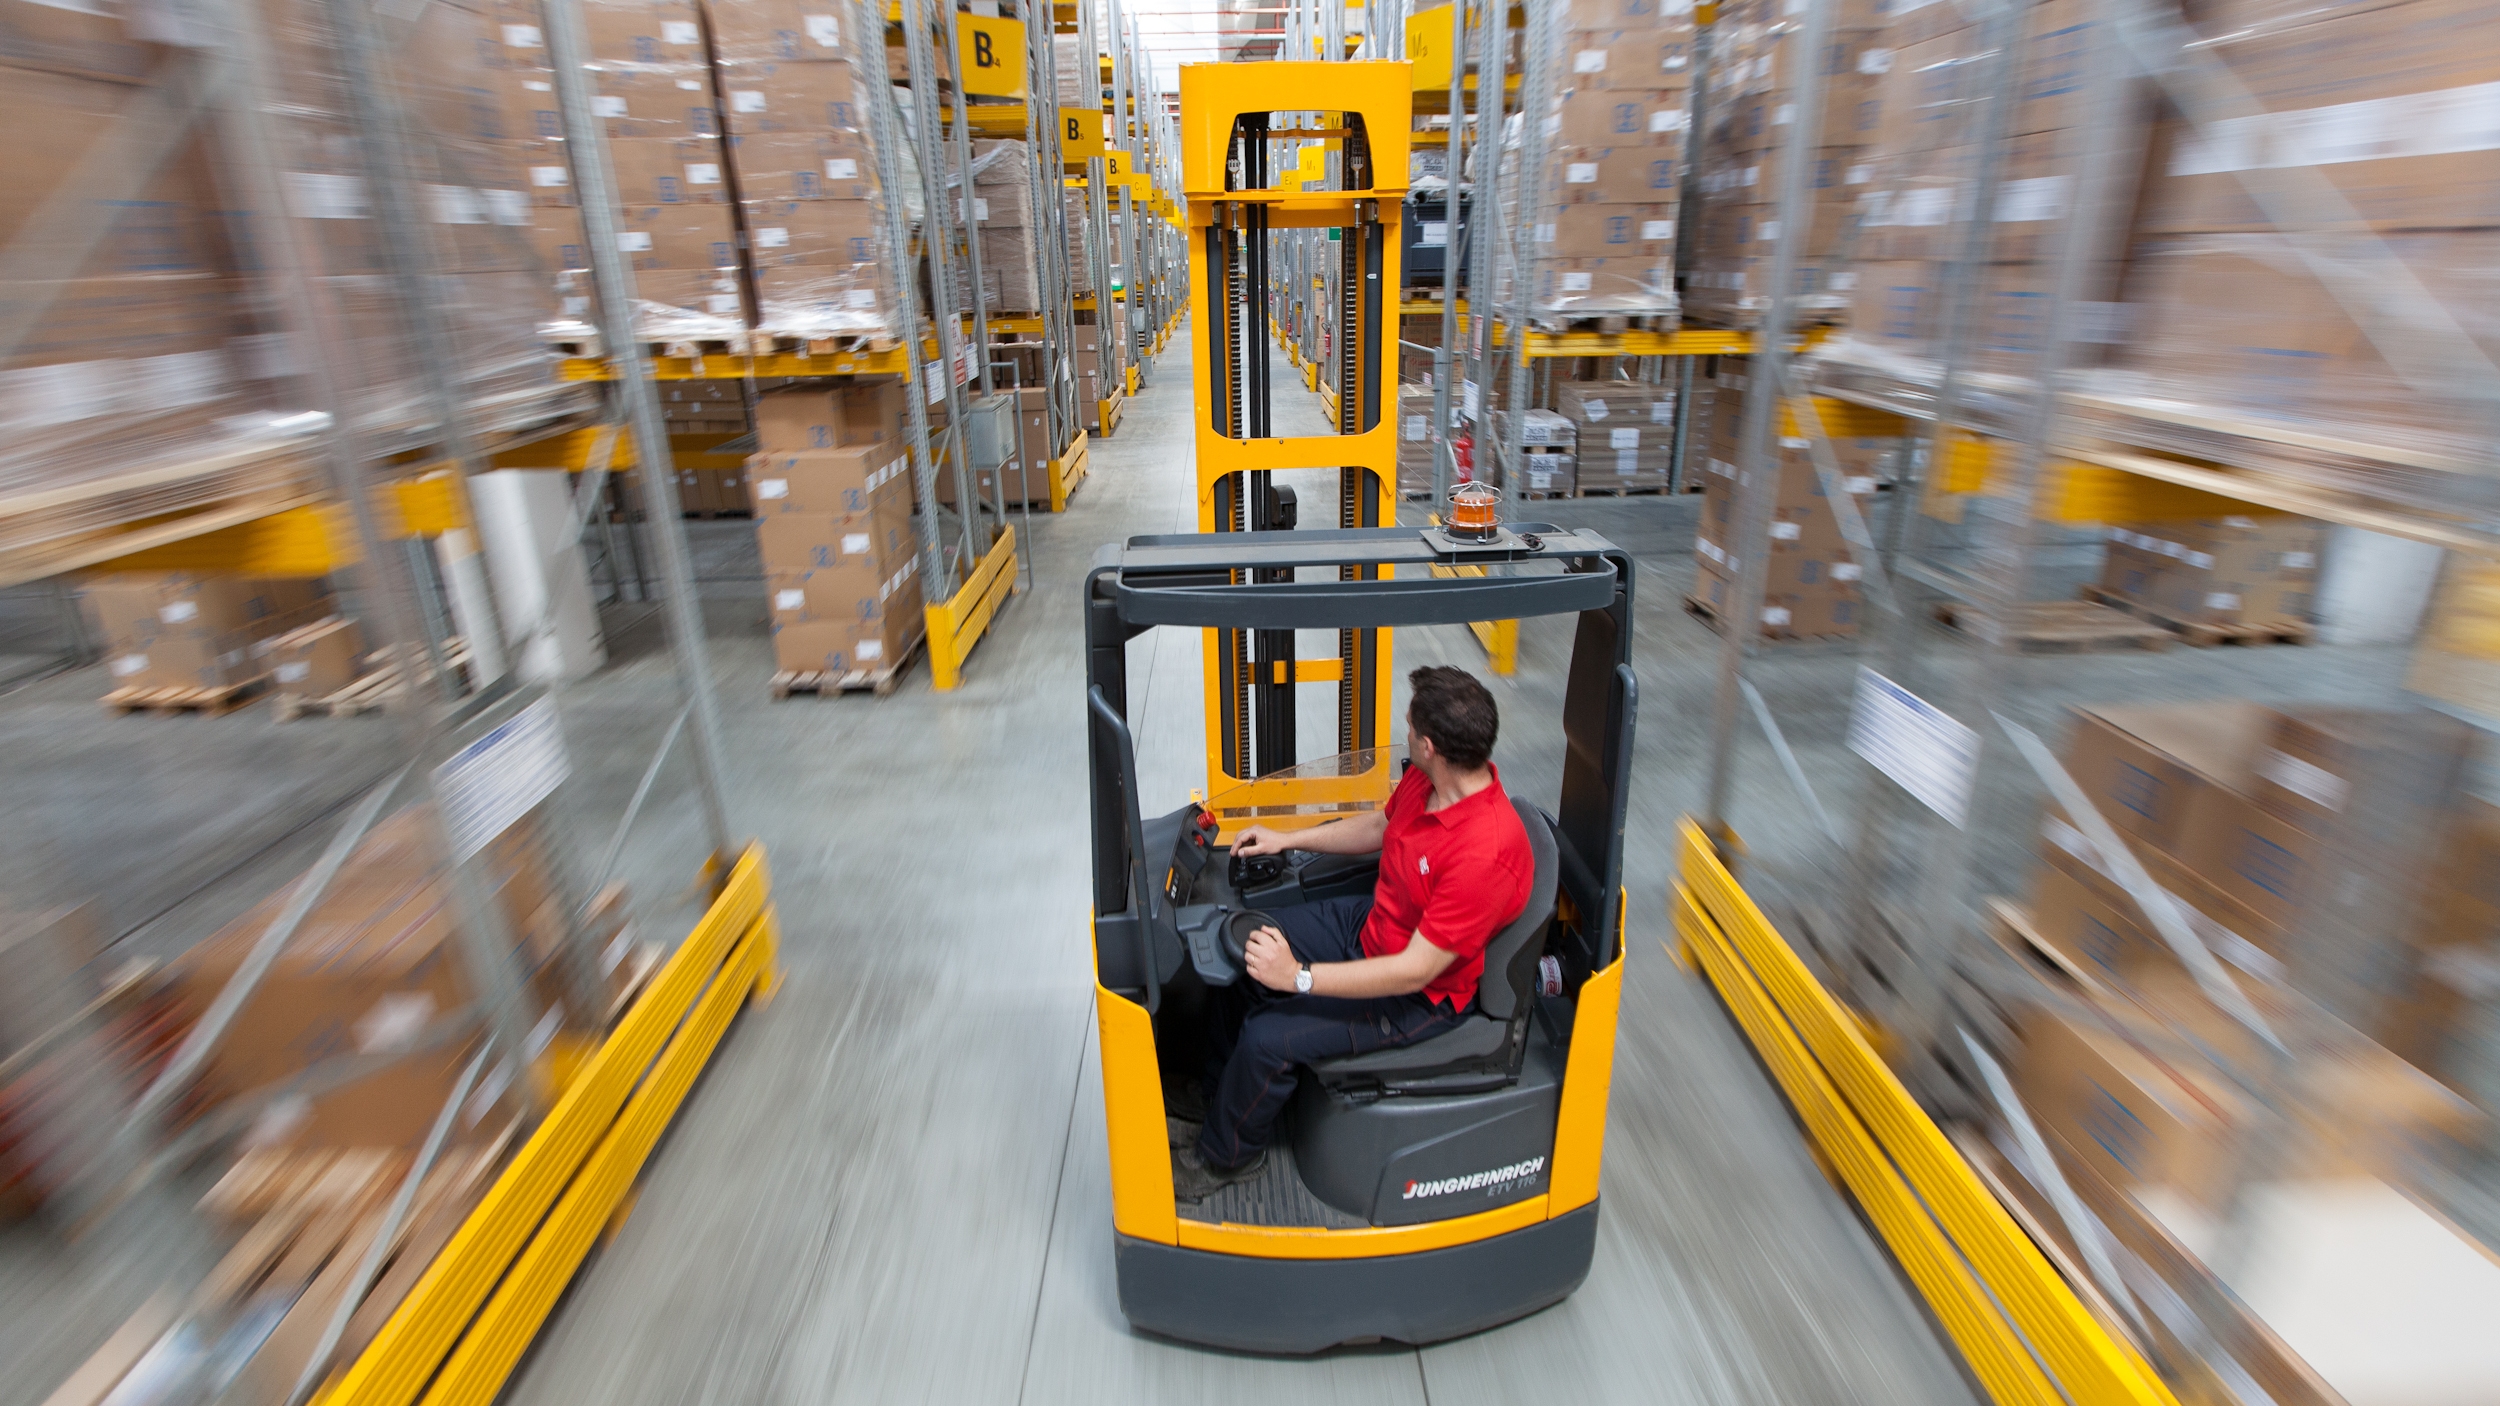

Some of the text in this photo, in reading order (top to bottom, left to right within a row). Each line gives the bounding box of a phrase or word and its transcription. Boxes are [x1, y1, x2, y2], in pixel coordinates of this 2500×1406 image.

[1402, 1156, 1544, 1199] JUNGHEINRICH
[1487, 1173, 1538, 1197] ETV 116
